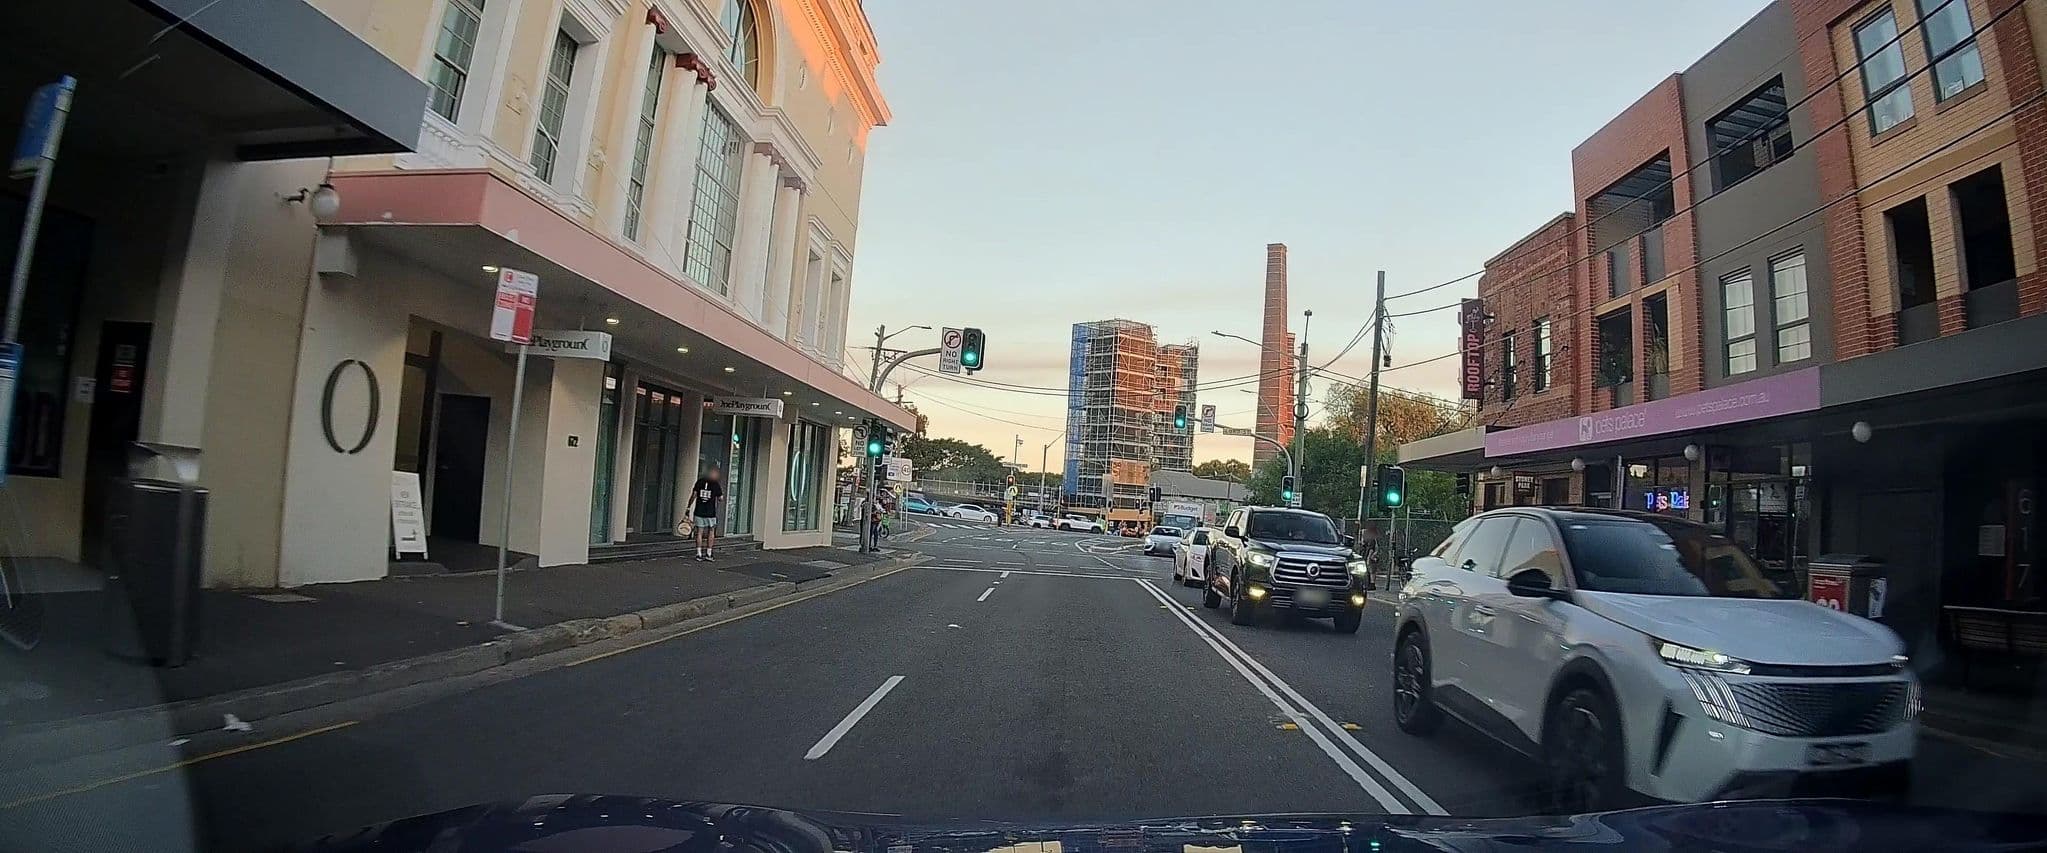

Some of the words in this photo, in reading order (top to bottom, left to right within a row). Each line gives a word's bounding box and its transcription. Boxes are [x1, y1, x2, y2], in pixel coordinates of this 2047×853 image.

[531, 335, 588, 352] Playground
[946, 350, 957, 358] NO
[943, 357, 958, 365] RIGHT
[1467, 333, 1480, 393] ROOFTOP
[1181, 504, 1198, 513] Budget
